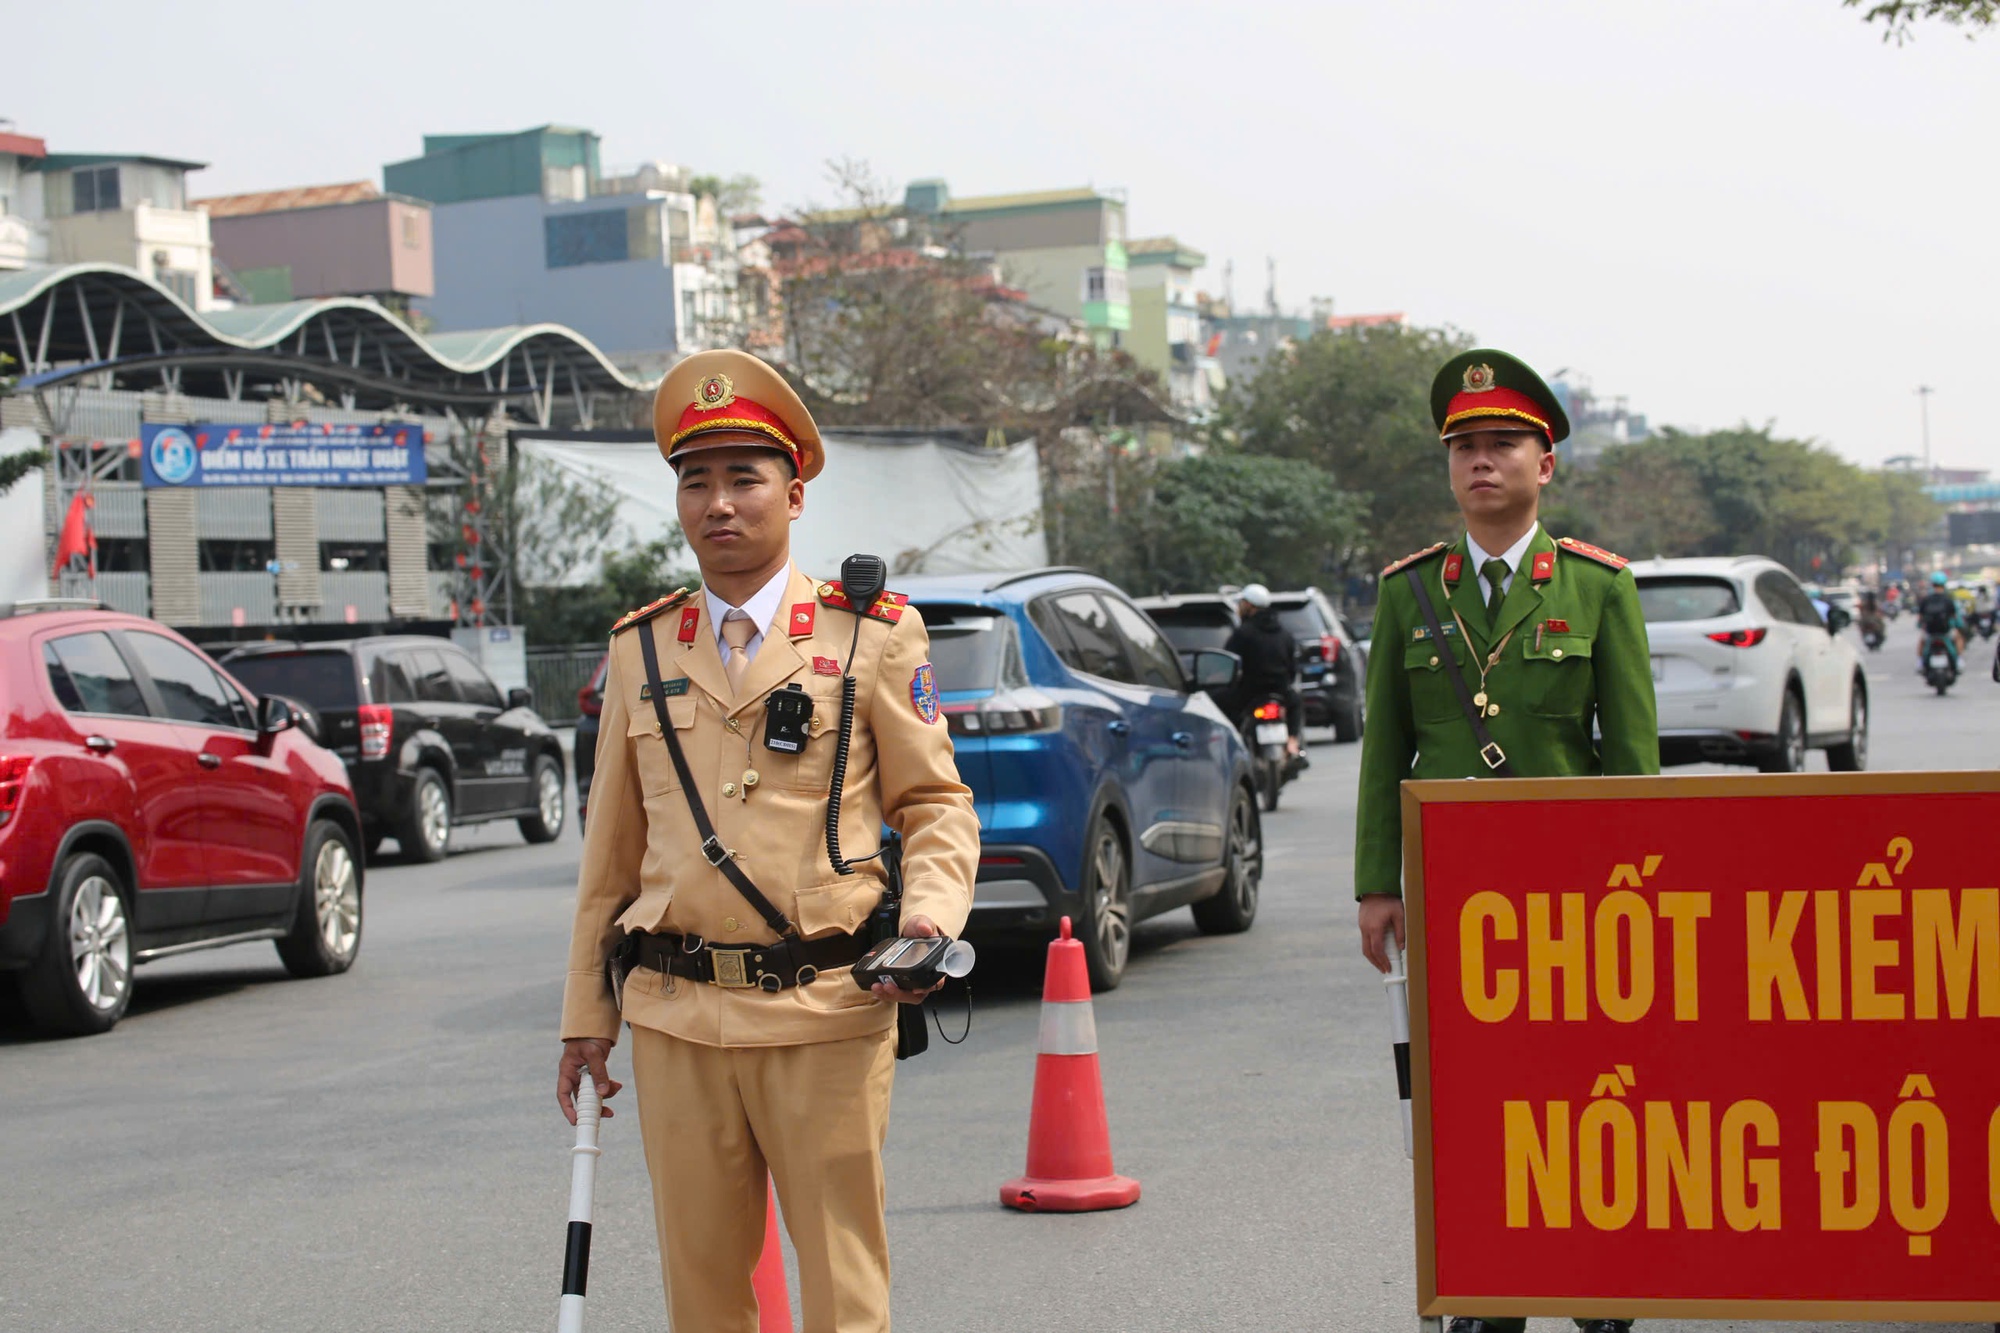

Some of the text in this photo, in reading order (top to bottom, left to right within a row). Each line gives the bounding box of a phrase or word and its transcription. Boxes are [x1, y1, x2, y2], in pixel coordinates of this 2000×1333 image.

[1459, 837, 2000, 1023] CHỐT KIỂM
[1503, 1064, 1782, 1231] NỒNG
[1814, 1073, 1949, 1256] ĐỘ
